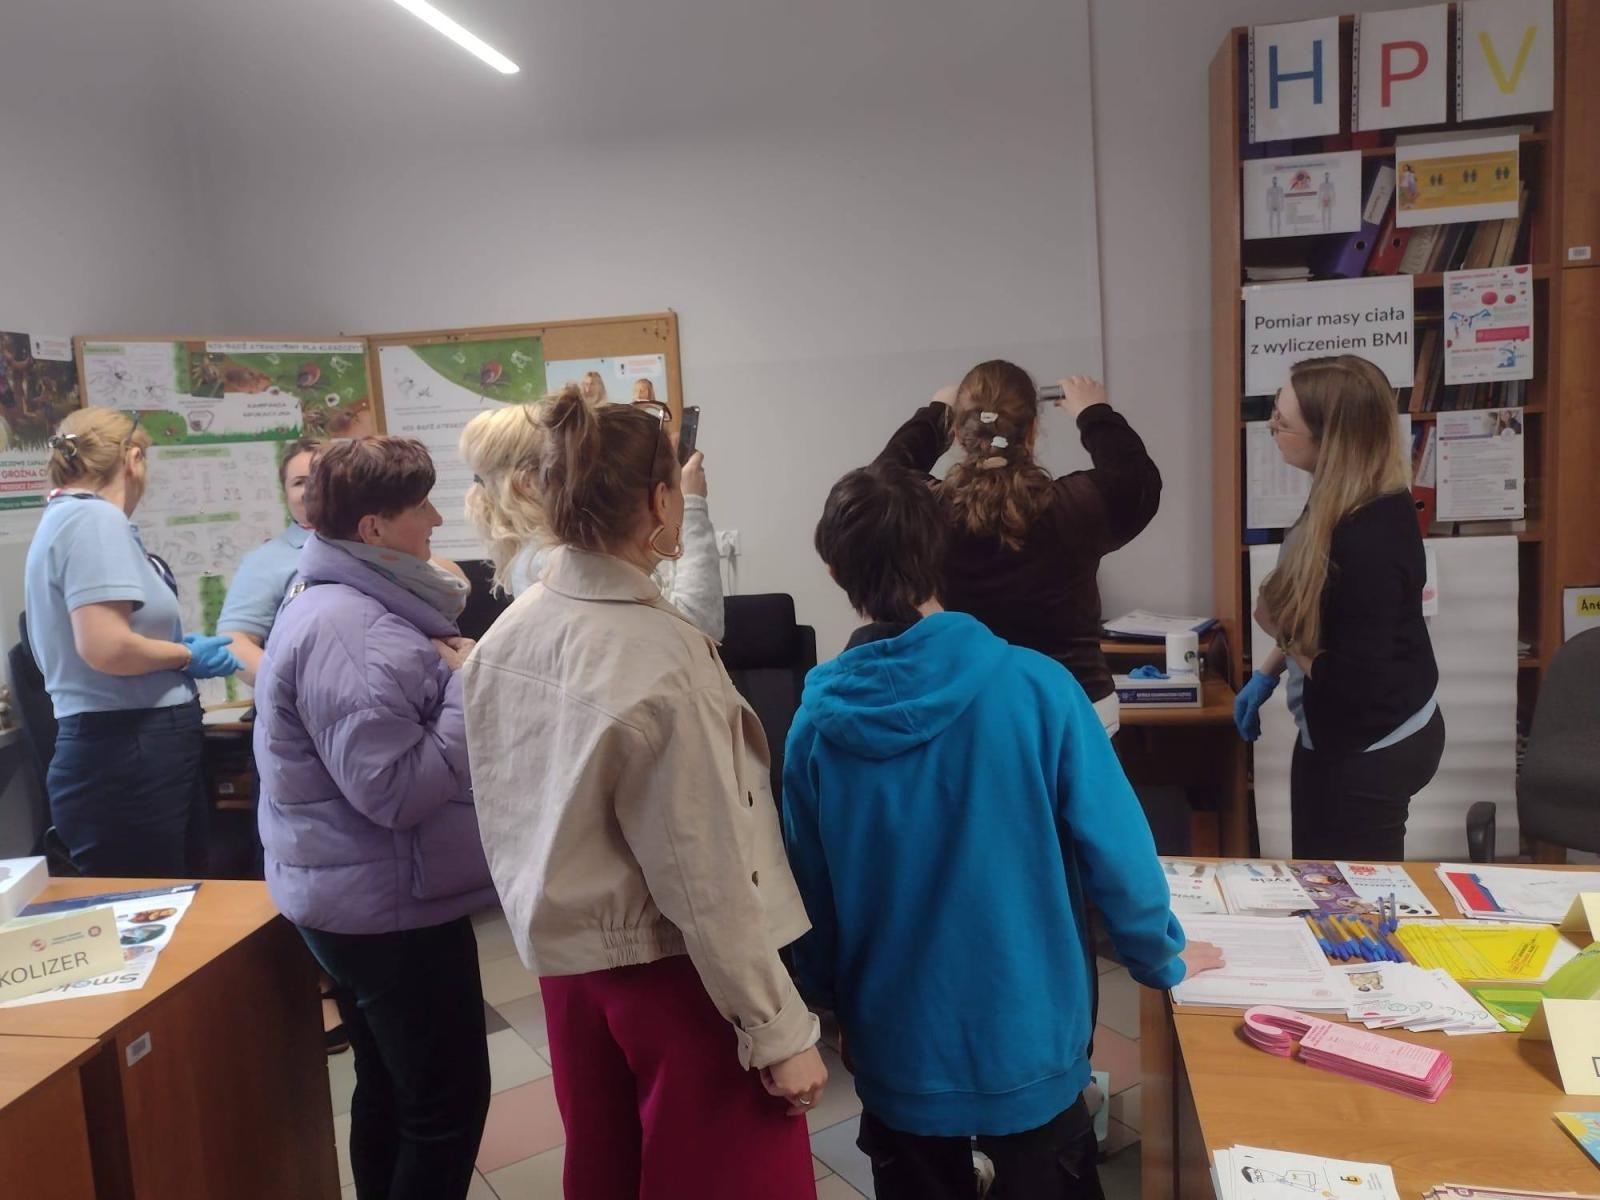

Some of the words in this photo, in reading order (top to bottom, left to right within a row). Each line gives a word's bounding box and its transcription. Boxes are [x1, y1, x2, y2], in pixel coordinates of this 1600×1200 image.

[1268, 39, 1323, 109] H
[1380, 40, 1430, 108] P
[1478, 25, 1538, 95] V
[1254, 314, 1313, 330] Pomiar
[1317, 312, 1360, 327] masy
[1364, 307, 1405, 323] ciała
[1250, 344, 1260, 355] z
[1263, 335, 1367, 355] wyliczeniem
[1372, 331, 1408, 347] BMI
[0, 951, 89, 986] KOLIZER
